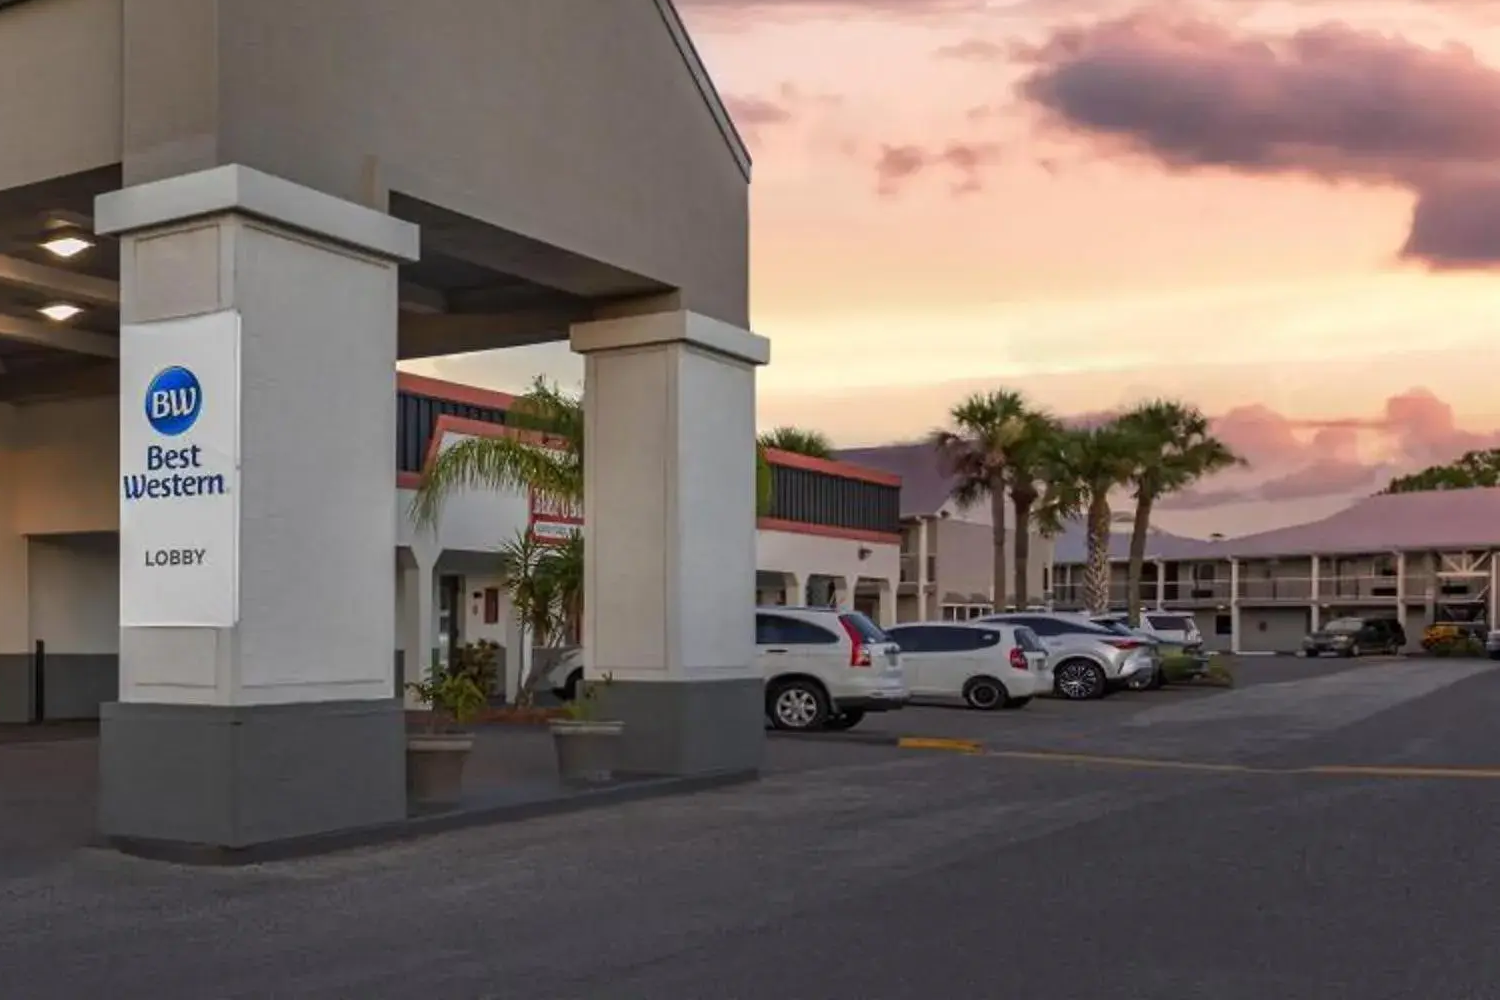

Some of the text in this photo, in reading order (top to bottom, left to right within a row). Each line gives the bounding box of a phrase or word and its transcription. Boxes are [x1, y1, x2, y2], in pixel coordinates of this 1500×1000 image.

[152, 387, 198, 419] BW
[147, 444, 202, 471] Best
[123, 473, 226, 500] Western
[144, 548, 206, 568] LOBBY
